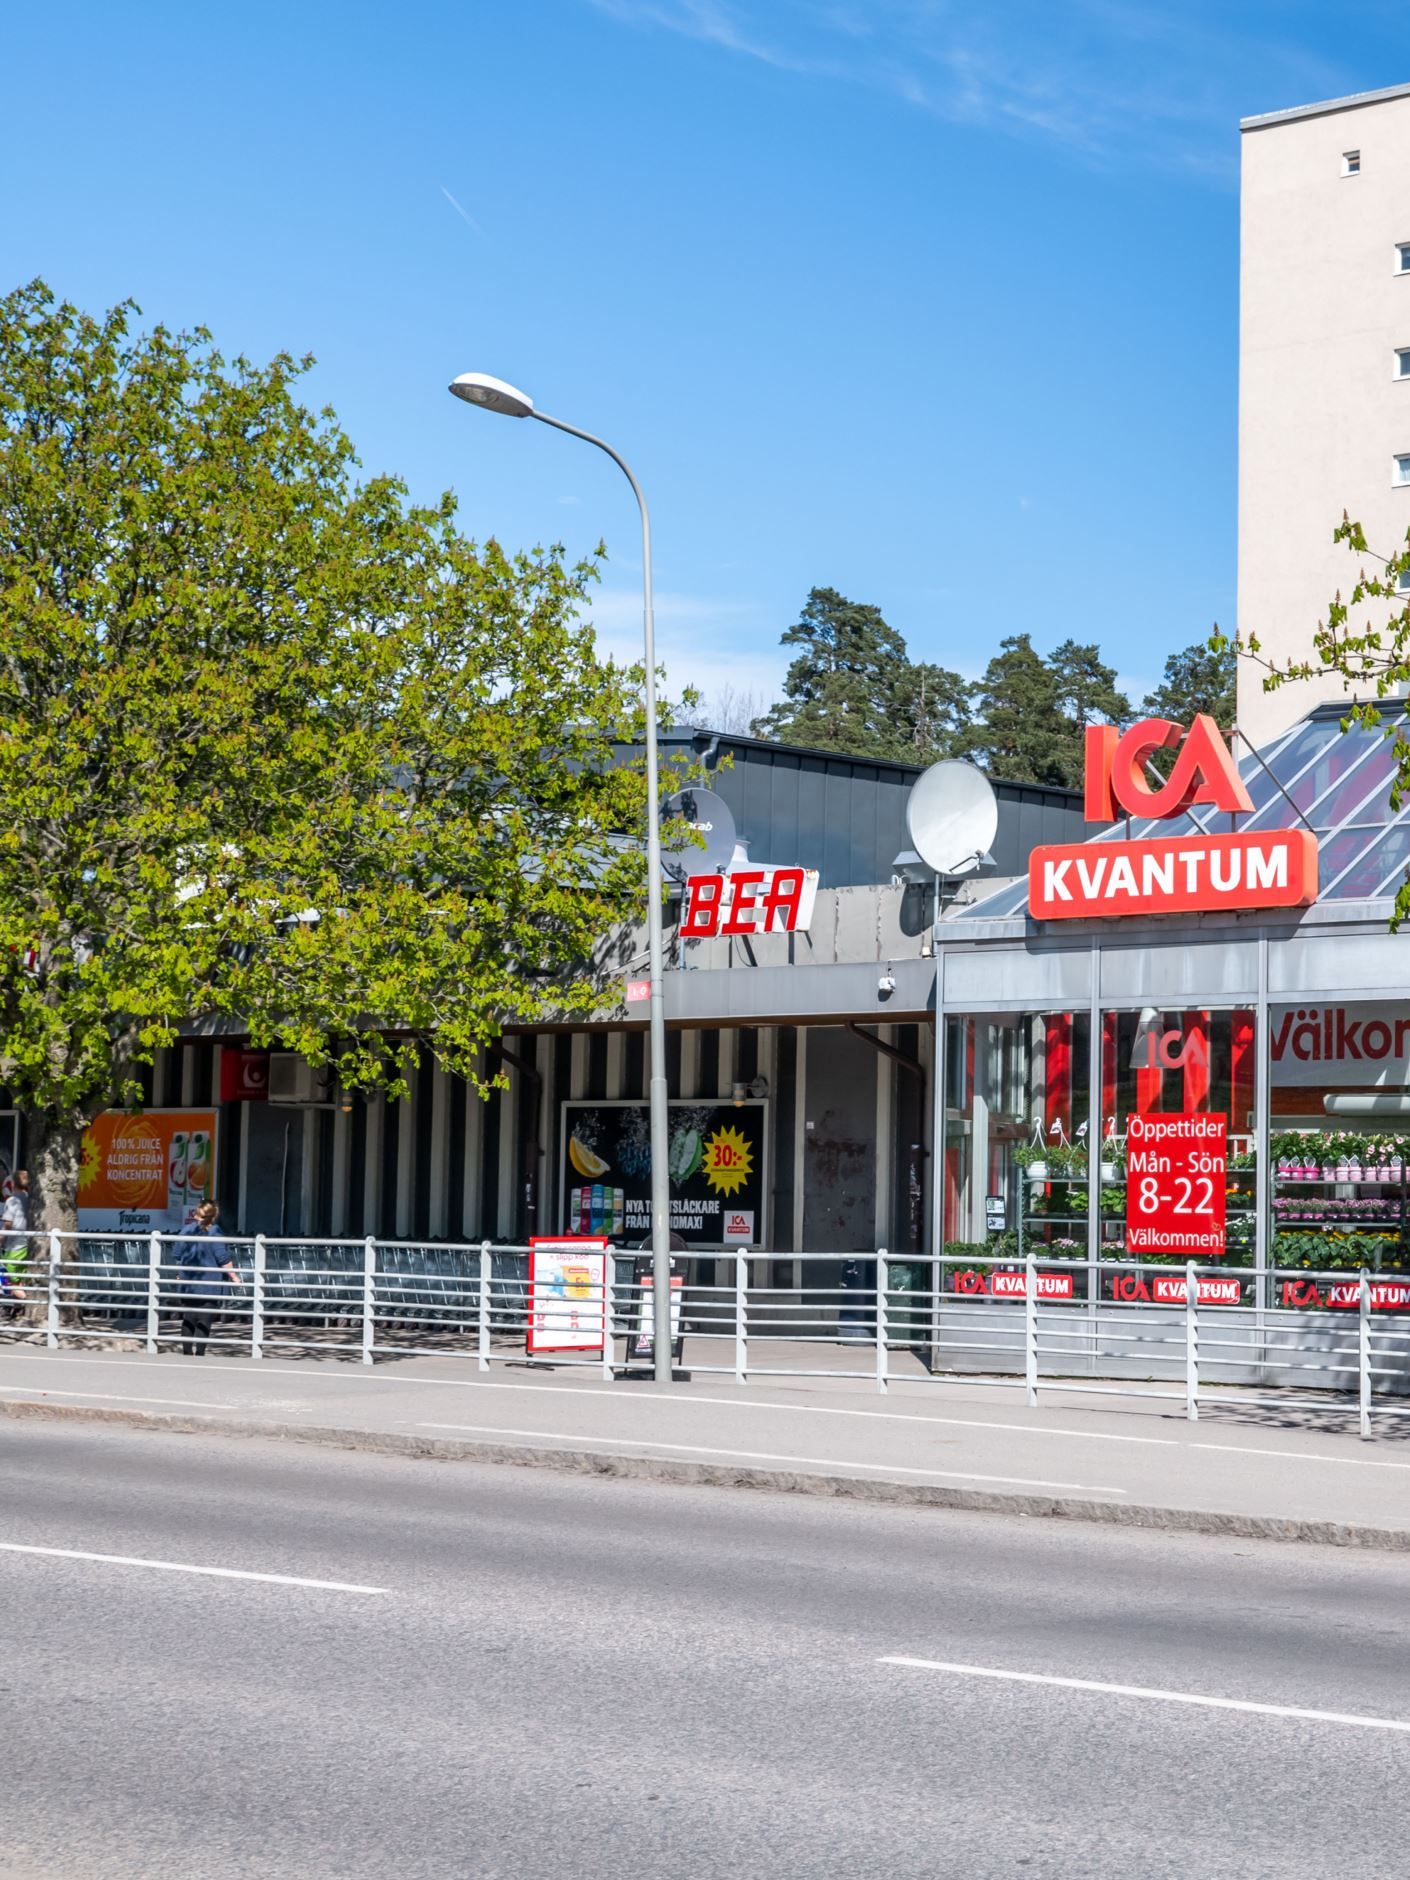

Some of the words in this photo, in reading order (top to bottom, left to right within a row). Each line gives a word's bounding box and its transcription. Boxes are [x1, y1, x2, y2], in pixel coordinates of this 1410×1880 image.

[1084, 712, 1256, 822] ICA
[1043, 844, 1288, 902] KVANTUM
[679, 868, 806, 939] BEA
[1146, 1026, 1208, 1069] ICA
[1129, 1116, 1224, 1143] Öppettider
[136, 1138, 161, 1150] JUICE
[106, 1153, 139, 1165] ALDRIG
[140, 1151, 164, 1165] FRÅN
[1129, 1150, 1171, 1173] Mån
[1188, 1151, 1225, 1173] Sön
[106, 1169, 164, 1180] KONCENTRAT
[625, 1200, 644, 1213] NYA
[1139, 1177, 1214, 1214] 8-22
[119, 1210, 151, 1226] Tropicana
[625, 1213, 650, 1228] FRÅN
[731, 1215, 746, 1226] ICA
[1128, 1227, 1224, 1248] Välkommen!
[953, 1271, 990, 1295] ICA
[995, 1276, 1069, 1294] KVATUM
[1112, 1275, 1151, 1301] ICA
[1282, 1280, 1323, 1306] ICA
